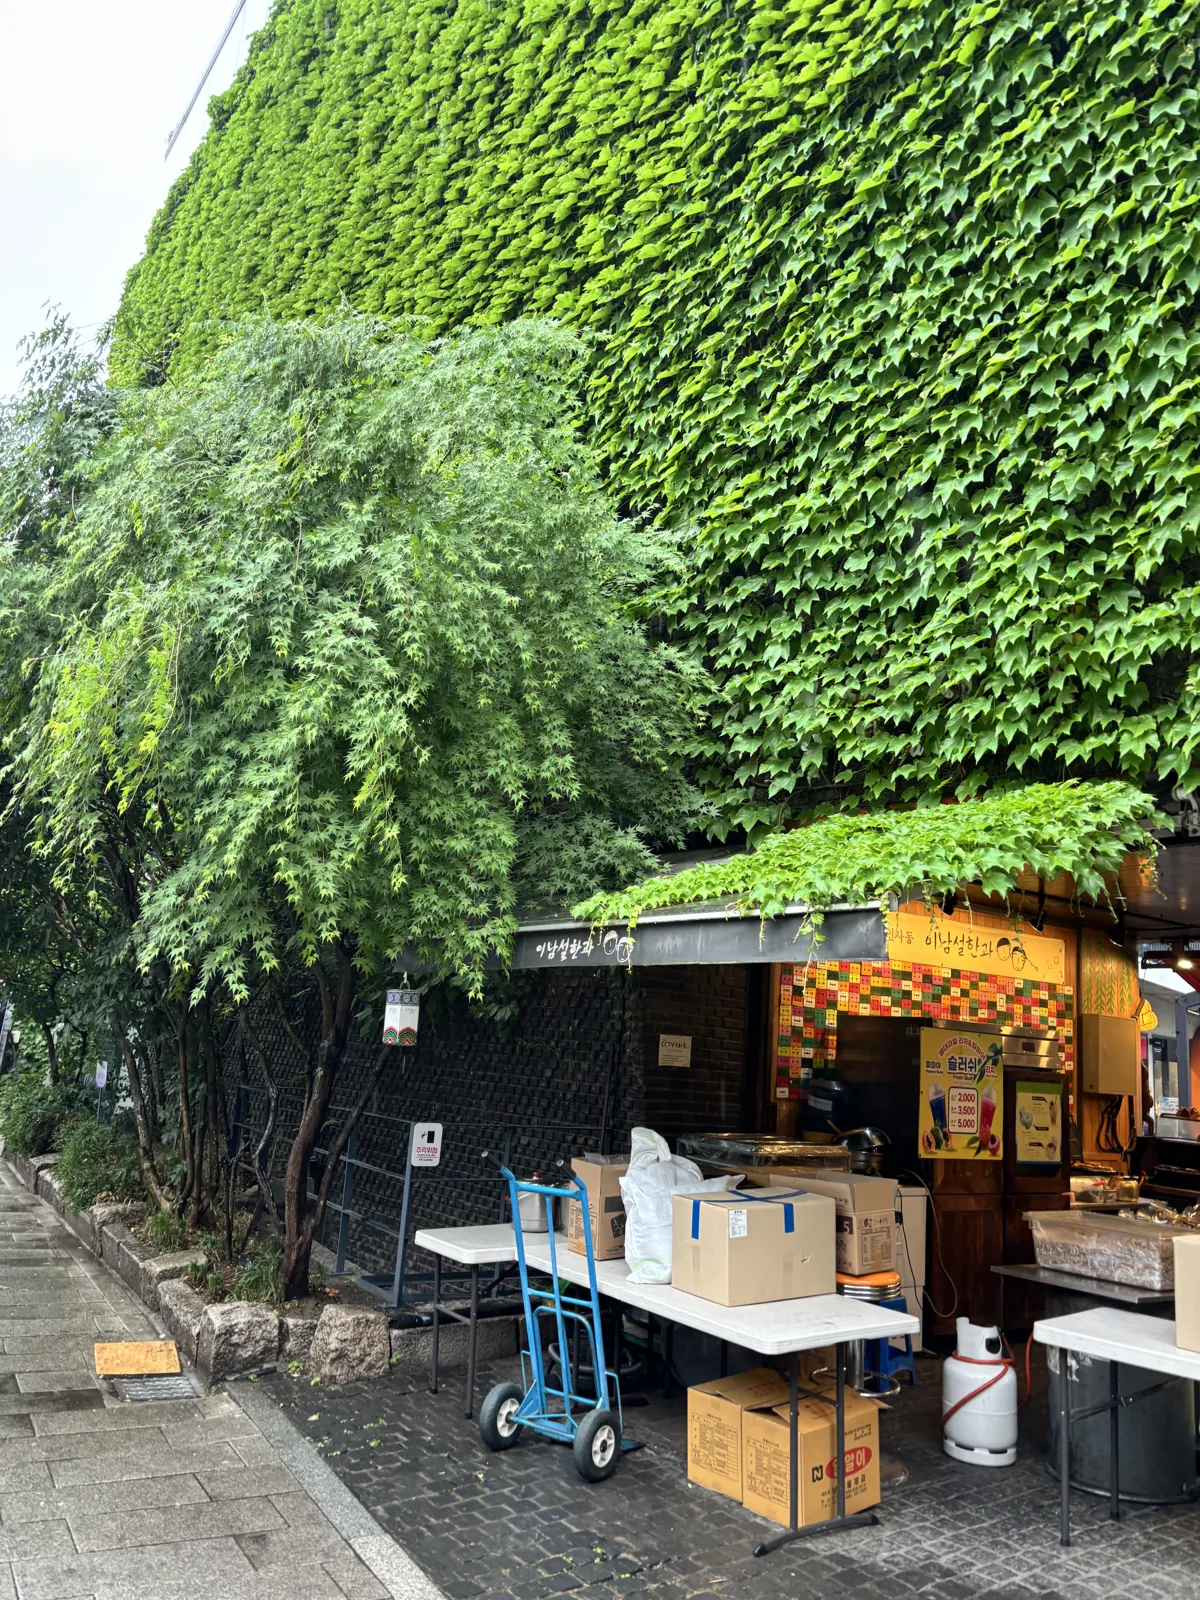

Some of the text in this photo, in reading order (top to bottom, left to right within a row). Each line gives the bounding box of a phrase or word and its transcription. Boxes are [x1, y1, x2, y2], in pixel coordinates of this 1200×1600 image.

[535, 937, 595, 962] 이남설한과
[925, 931, 994, 959] 이남설한과
[948, 1055, 977, 1073] 슬러쉬
[957, 1092, 976, 1103] 2,000
[957, 1105, 976, 1116] 3,500
[957, 1118, 976, 1129] 5,000
